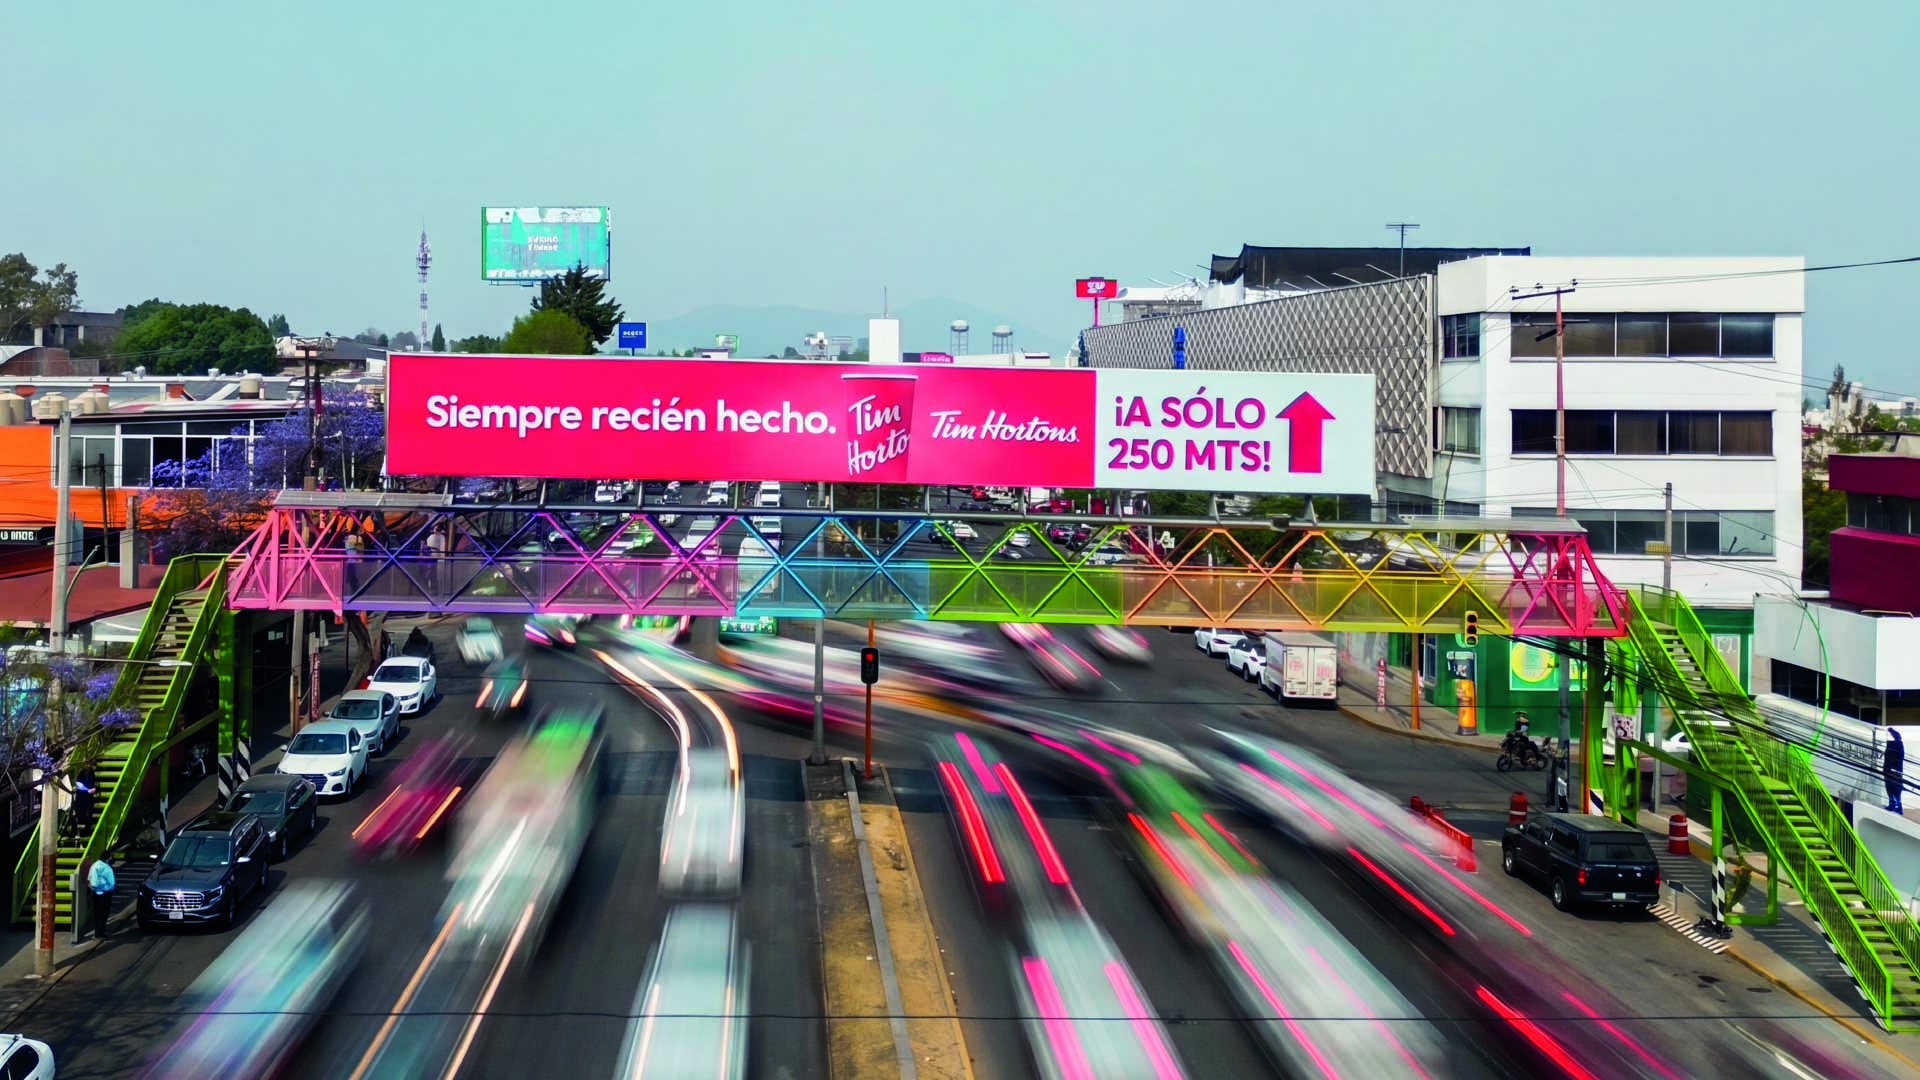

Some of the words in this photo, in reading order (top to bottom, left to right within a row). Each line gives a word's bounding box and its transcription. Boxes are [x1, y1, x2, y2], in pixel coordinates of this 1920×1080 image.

[426, 395, 583, 438] Siempre
[591, 397, 706, 432] recién
[716, 399, 837, 435] hecho.
[848, 395, 902, 435] Tim
[930, 410, 976, 441] Tim
[979, 410, 1078, 442] Hortons
[1114, 396, 1152, 428] ¡A
[1160, 386, 1266, 430] SÓLO
[1107, 438, 1175, 470] 250
[1184, 440, 1271, 472] MTS!
